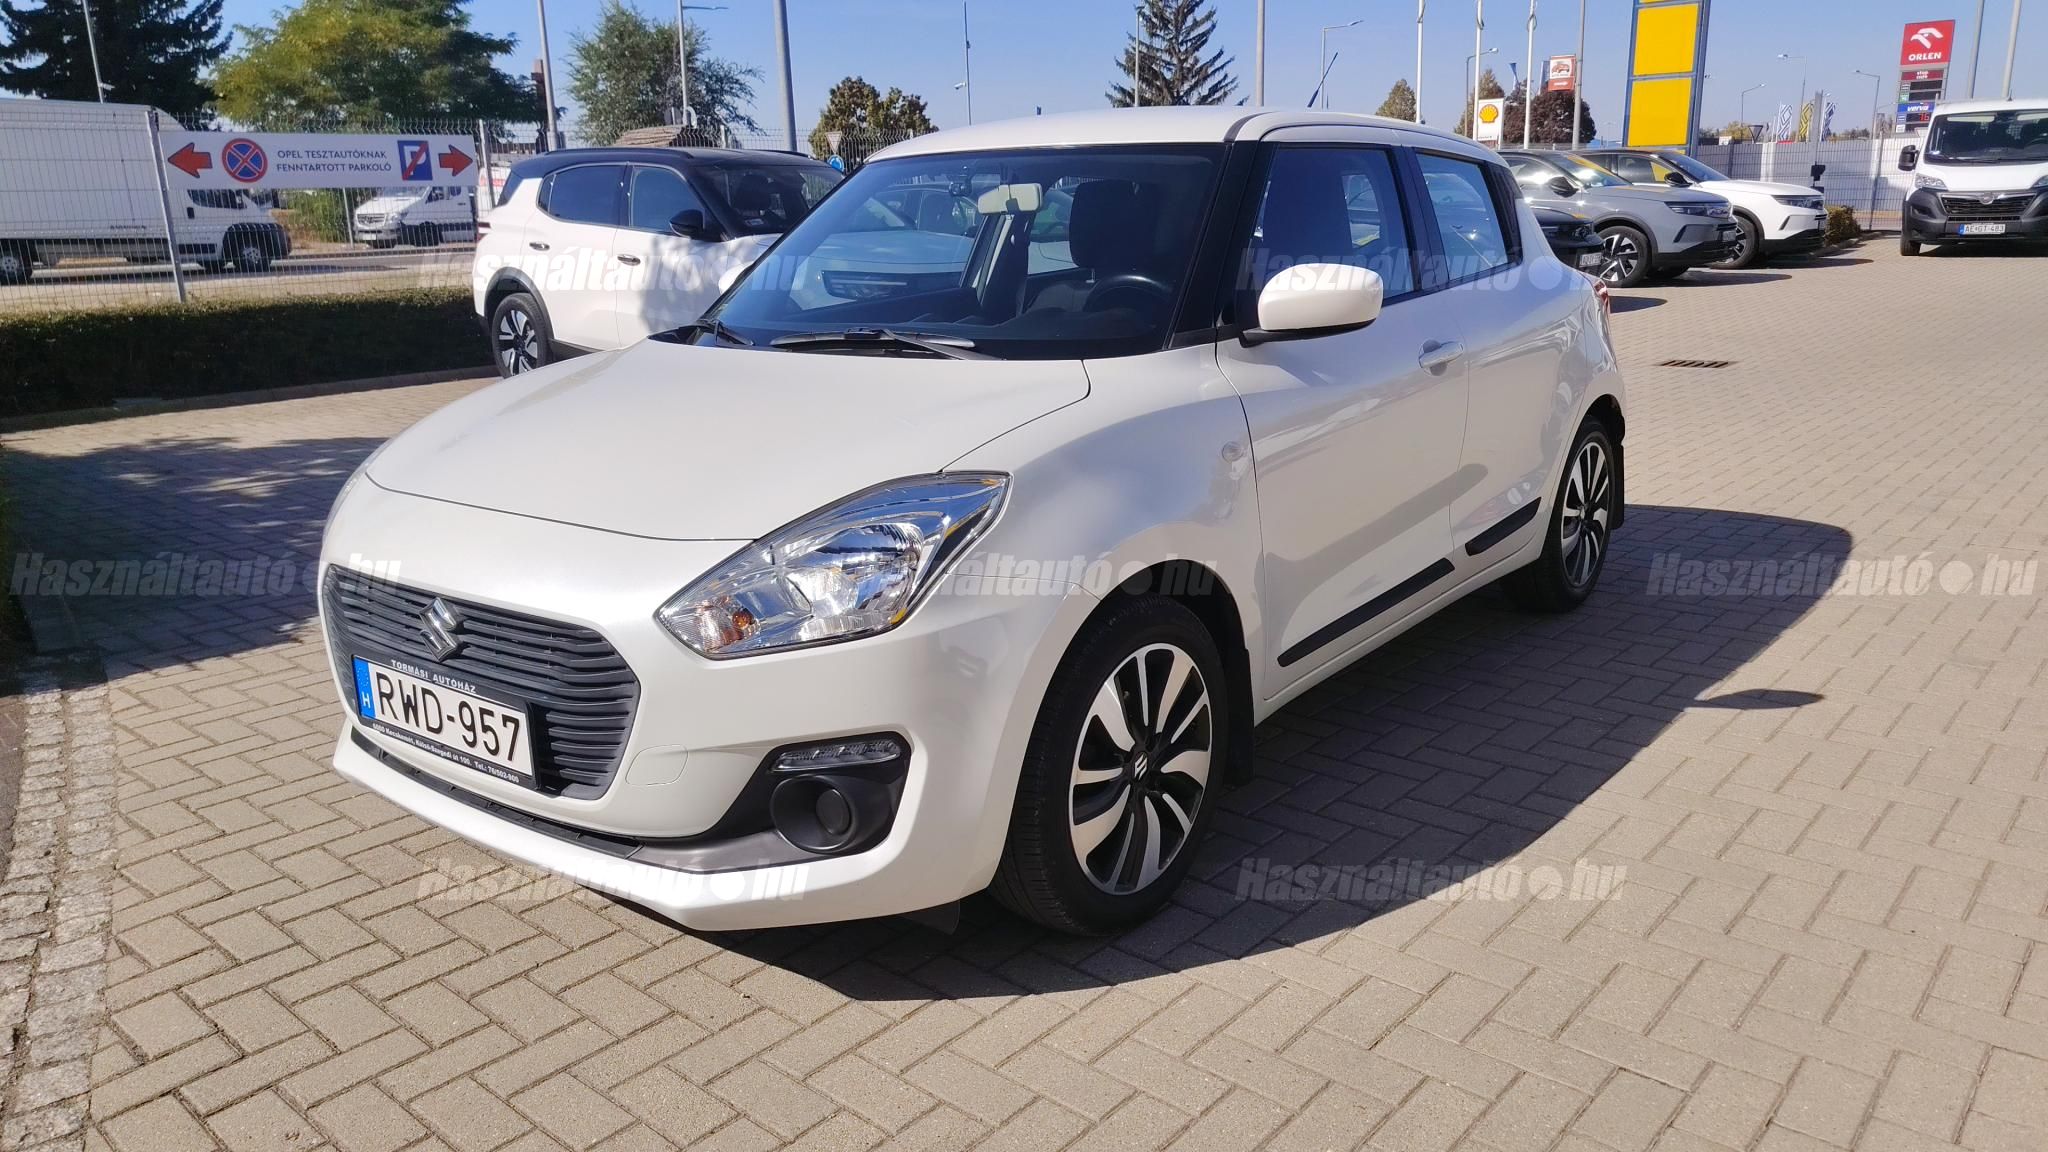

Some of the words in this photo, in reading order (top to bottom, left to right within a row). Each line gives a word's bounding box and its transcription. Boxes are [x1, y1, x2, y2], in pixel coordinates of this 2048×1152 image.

[1908, 52, 1941, 61] ORLEN
[277, 150, 303, 159] OPEL
[305, 149, 387, 160] TESZTAUTÓKNAK
[276, 163, 346, 172] FENNTARTOTT
[348, 162, 392, 172] PARKOLÓ
[390, 659, 429, 679] TORMÁSI
[432, 673, 477, 694] AUTÓHÁZ
[361, 691, 371, 709] H
[375, 671, 520, 762] RWD-957
[372, 722, 386, 733] 6000
[474, 761, 487, 772] Tel.:
